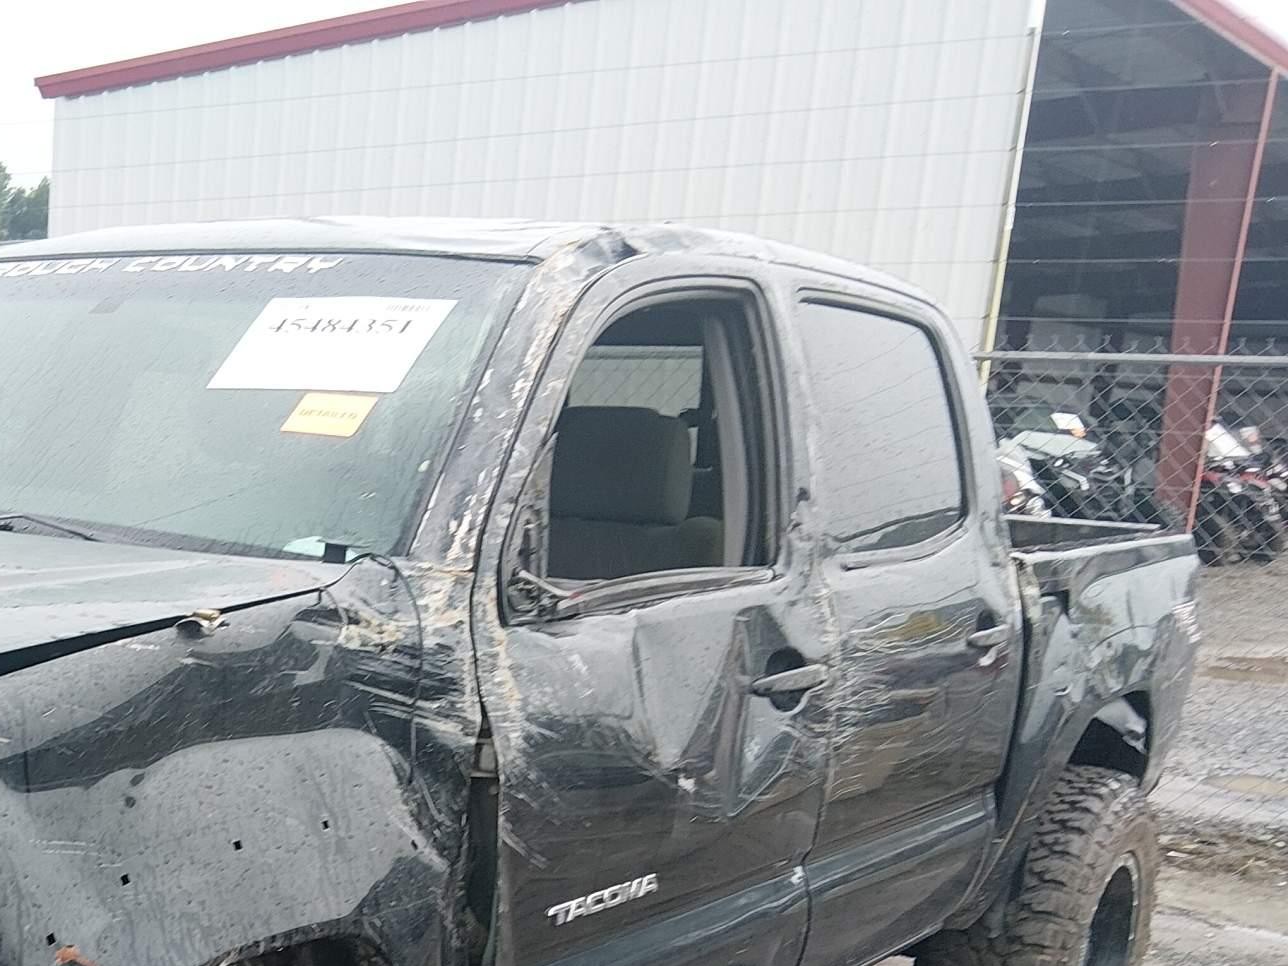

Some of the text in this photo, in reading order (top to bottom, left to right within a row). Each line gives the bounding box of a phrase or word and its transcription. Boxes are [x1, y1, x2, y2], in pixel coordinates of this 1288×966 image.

[122, 255, 345, 274] COUNTRY
[268, 317, 416, 335] 45484351
[544, 873, 659, 927] TACOMA
